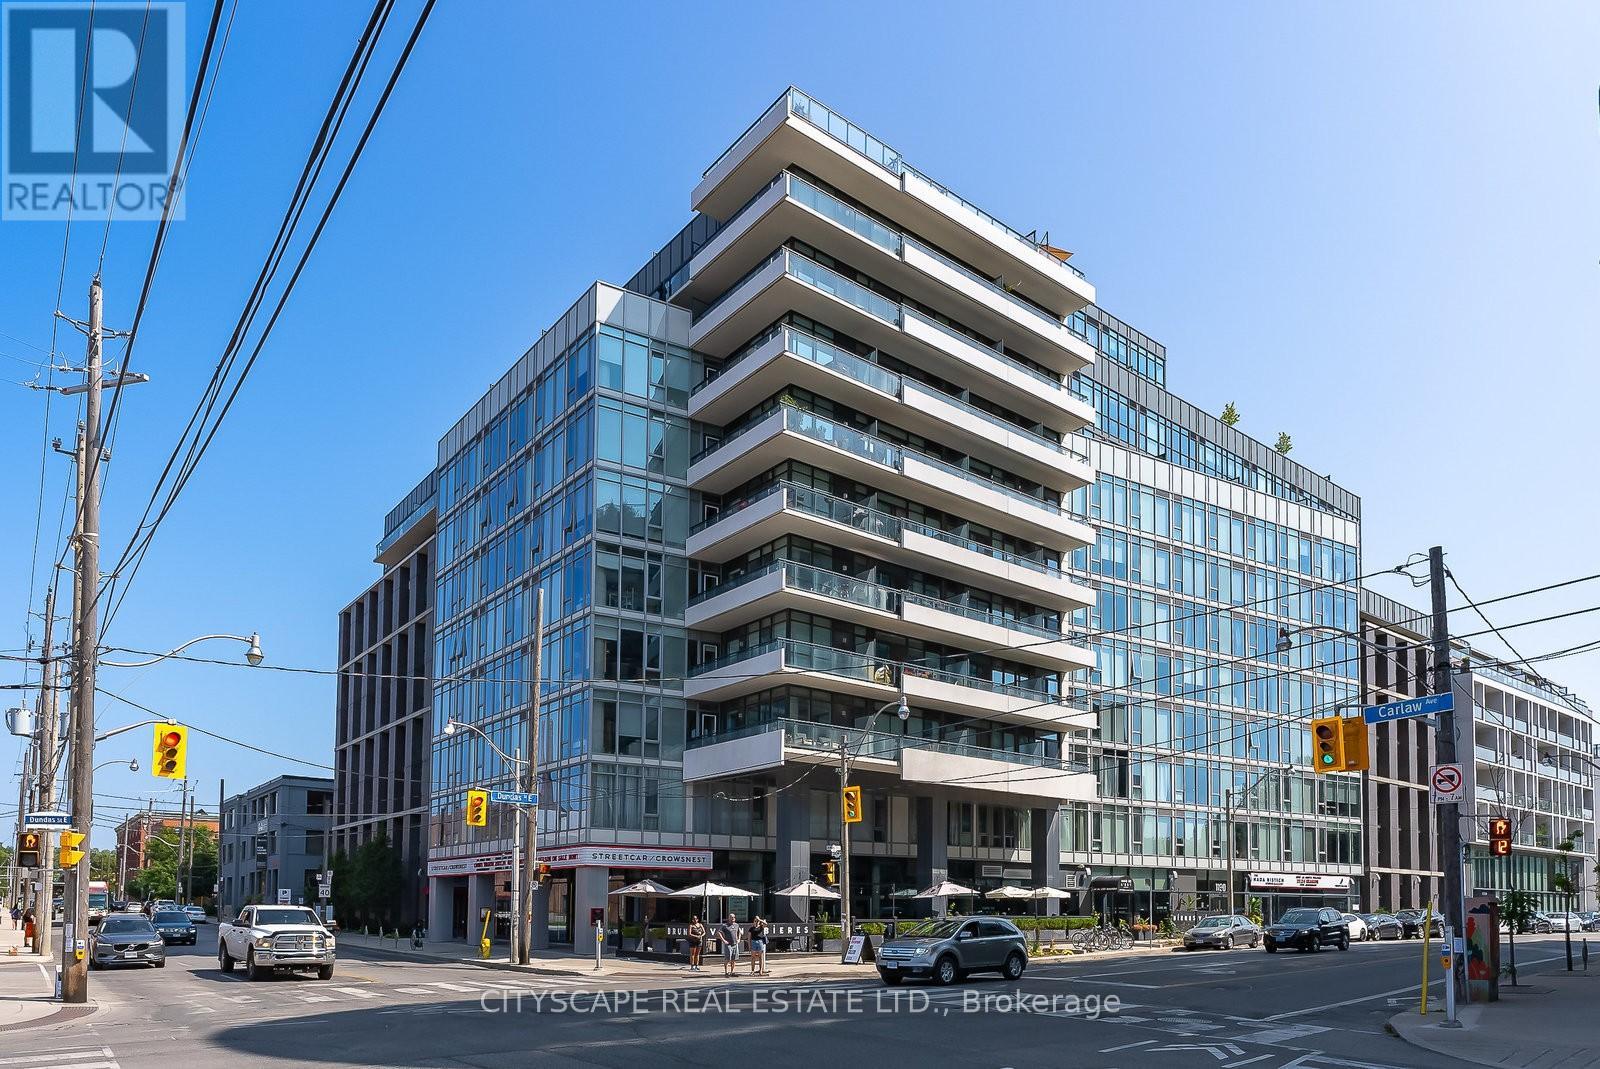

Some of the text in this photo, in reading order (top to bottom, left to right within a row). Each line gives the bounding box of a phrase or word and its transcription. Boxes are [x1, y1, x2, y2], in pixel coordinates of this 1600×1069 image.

[1378, 703, 1422, 718] Carlaw
[497, 792, 521, 801] Dundas
[528, 794, 533, 802] E
[591, 852, 706, 863] STREETCAR/CROWSNEST
